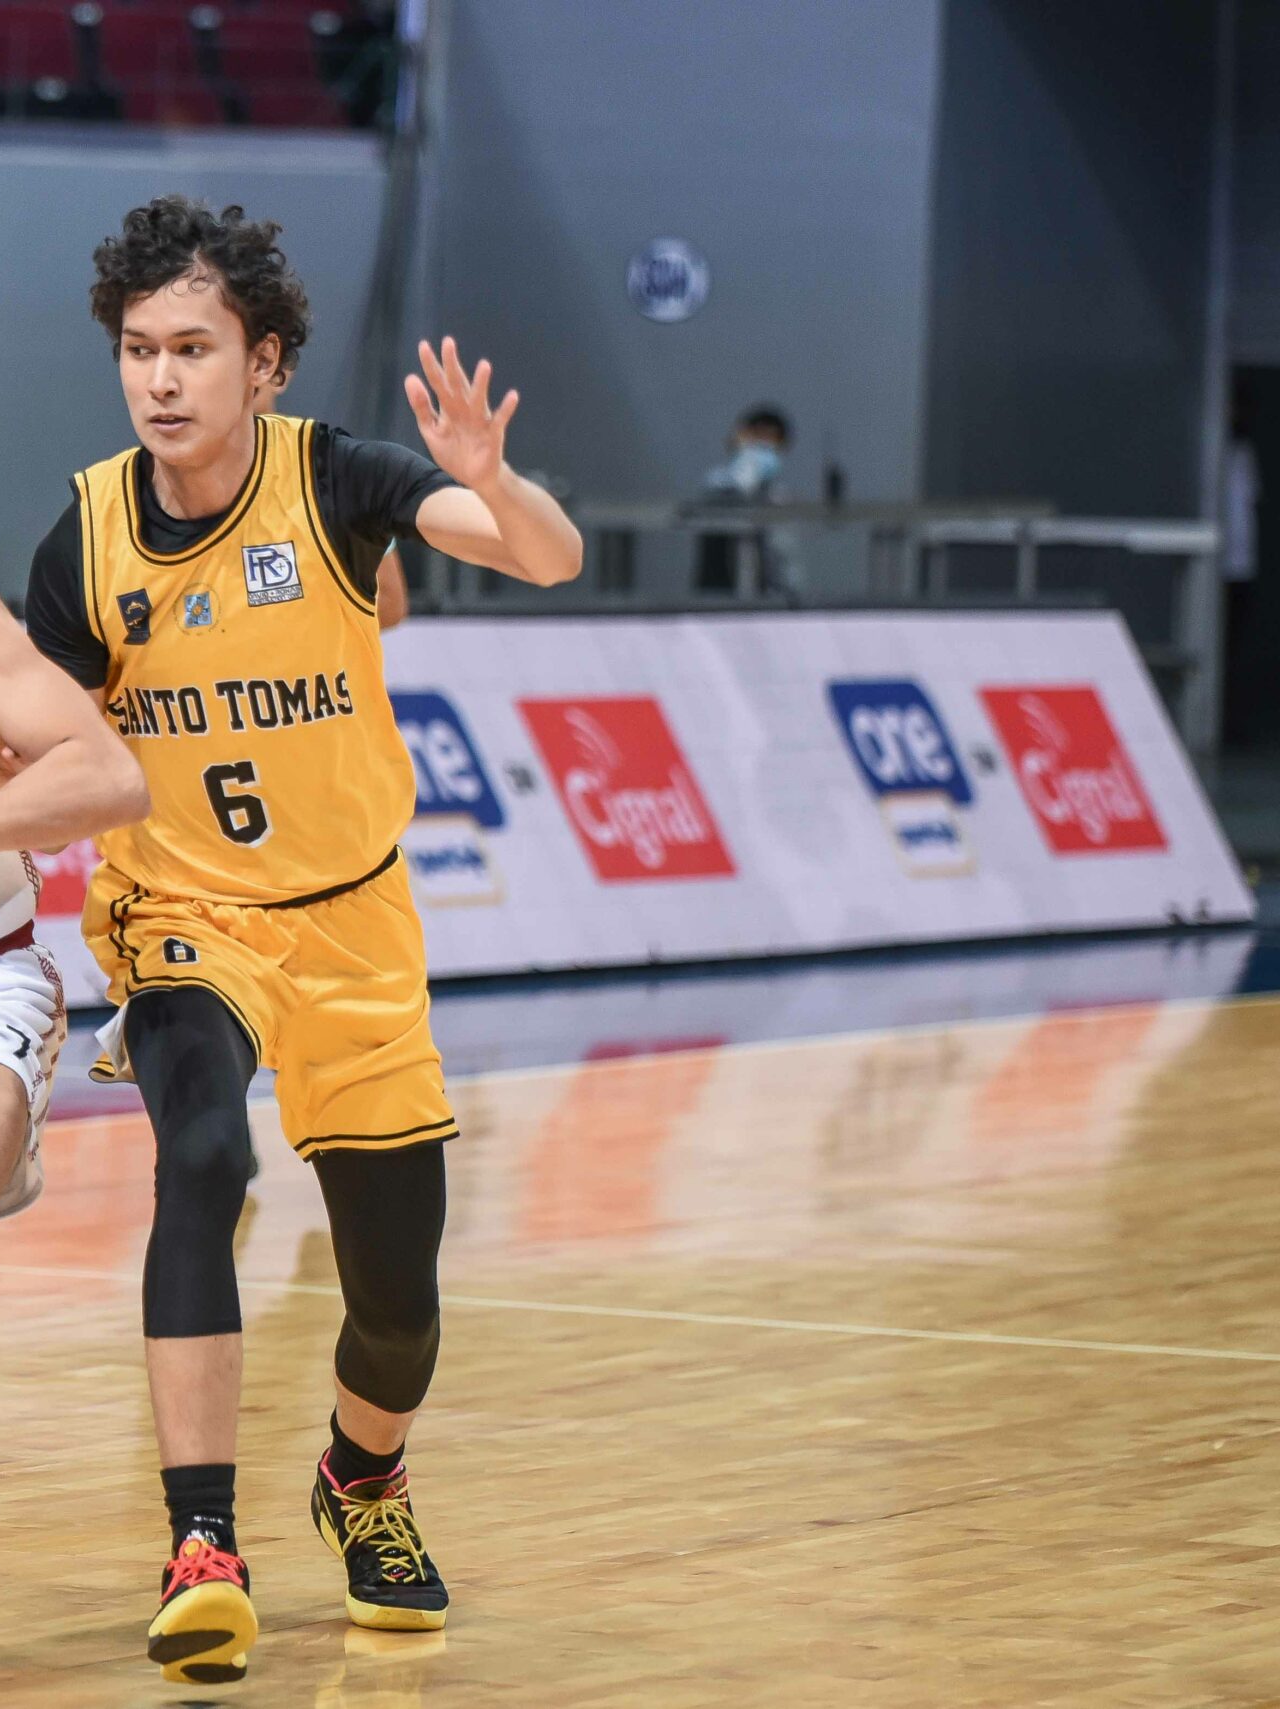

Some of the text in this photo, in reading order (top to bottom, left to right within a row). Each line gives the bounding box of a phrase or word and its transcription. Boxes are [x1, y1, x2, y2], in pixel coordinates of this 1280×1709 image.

[107, 670, 354, 738] SANTO TOMAS
[202, 760, 273, 848] 6
[565, 763, 708, 869] Cignal
[1021, 748, 1143, 843] Cignal
